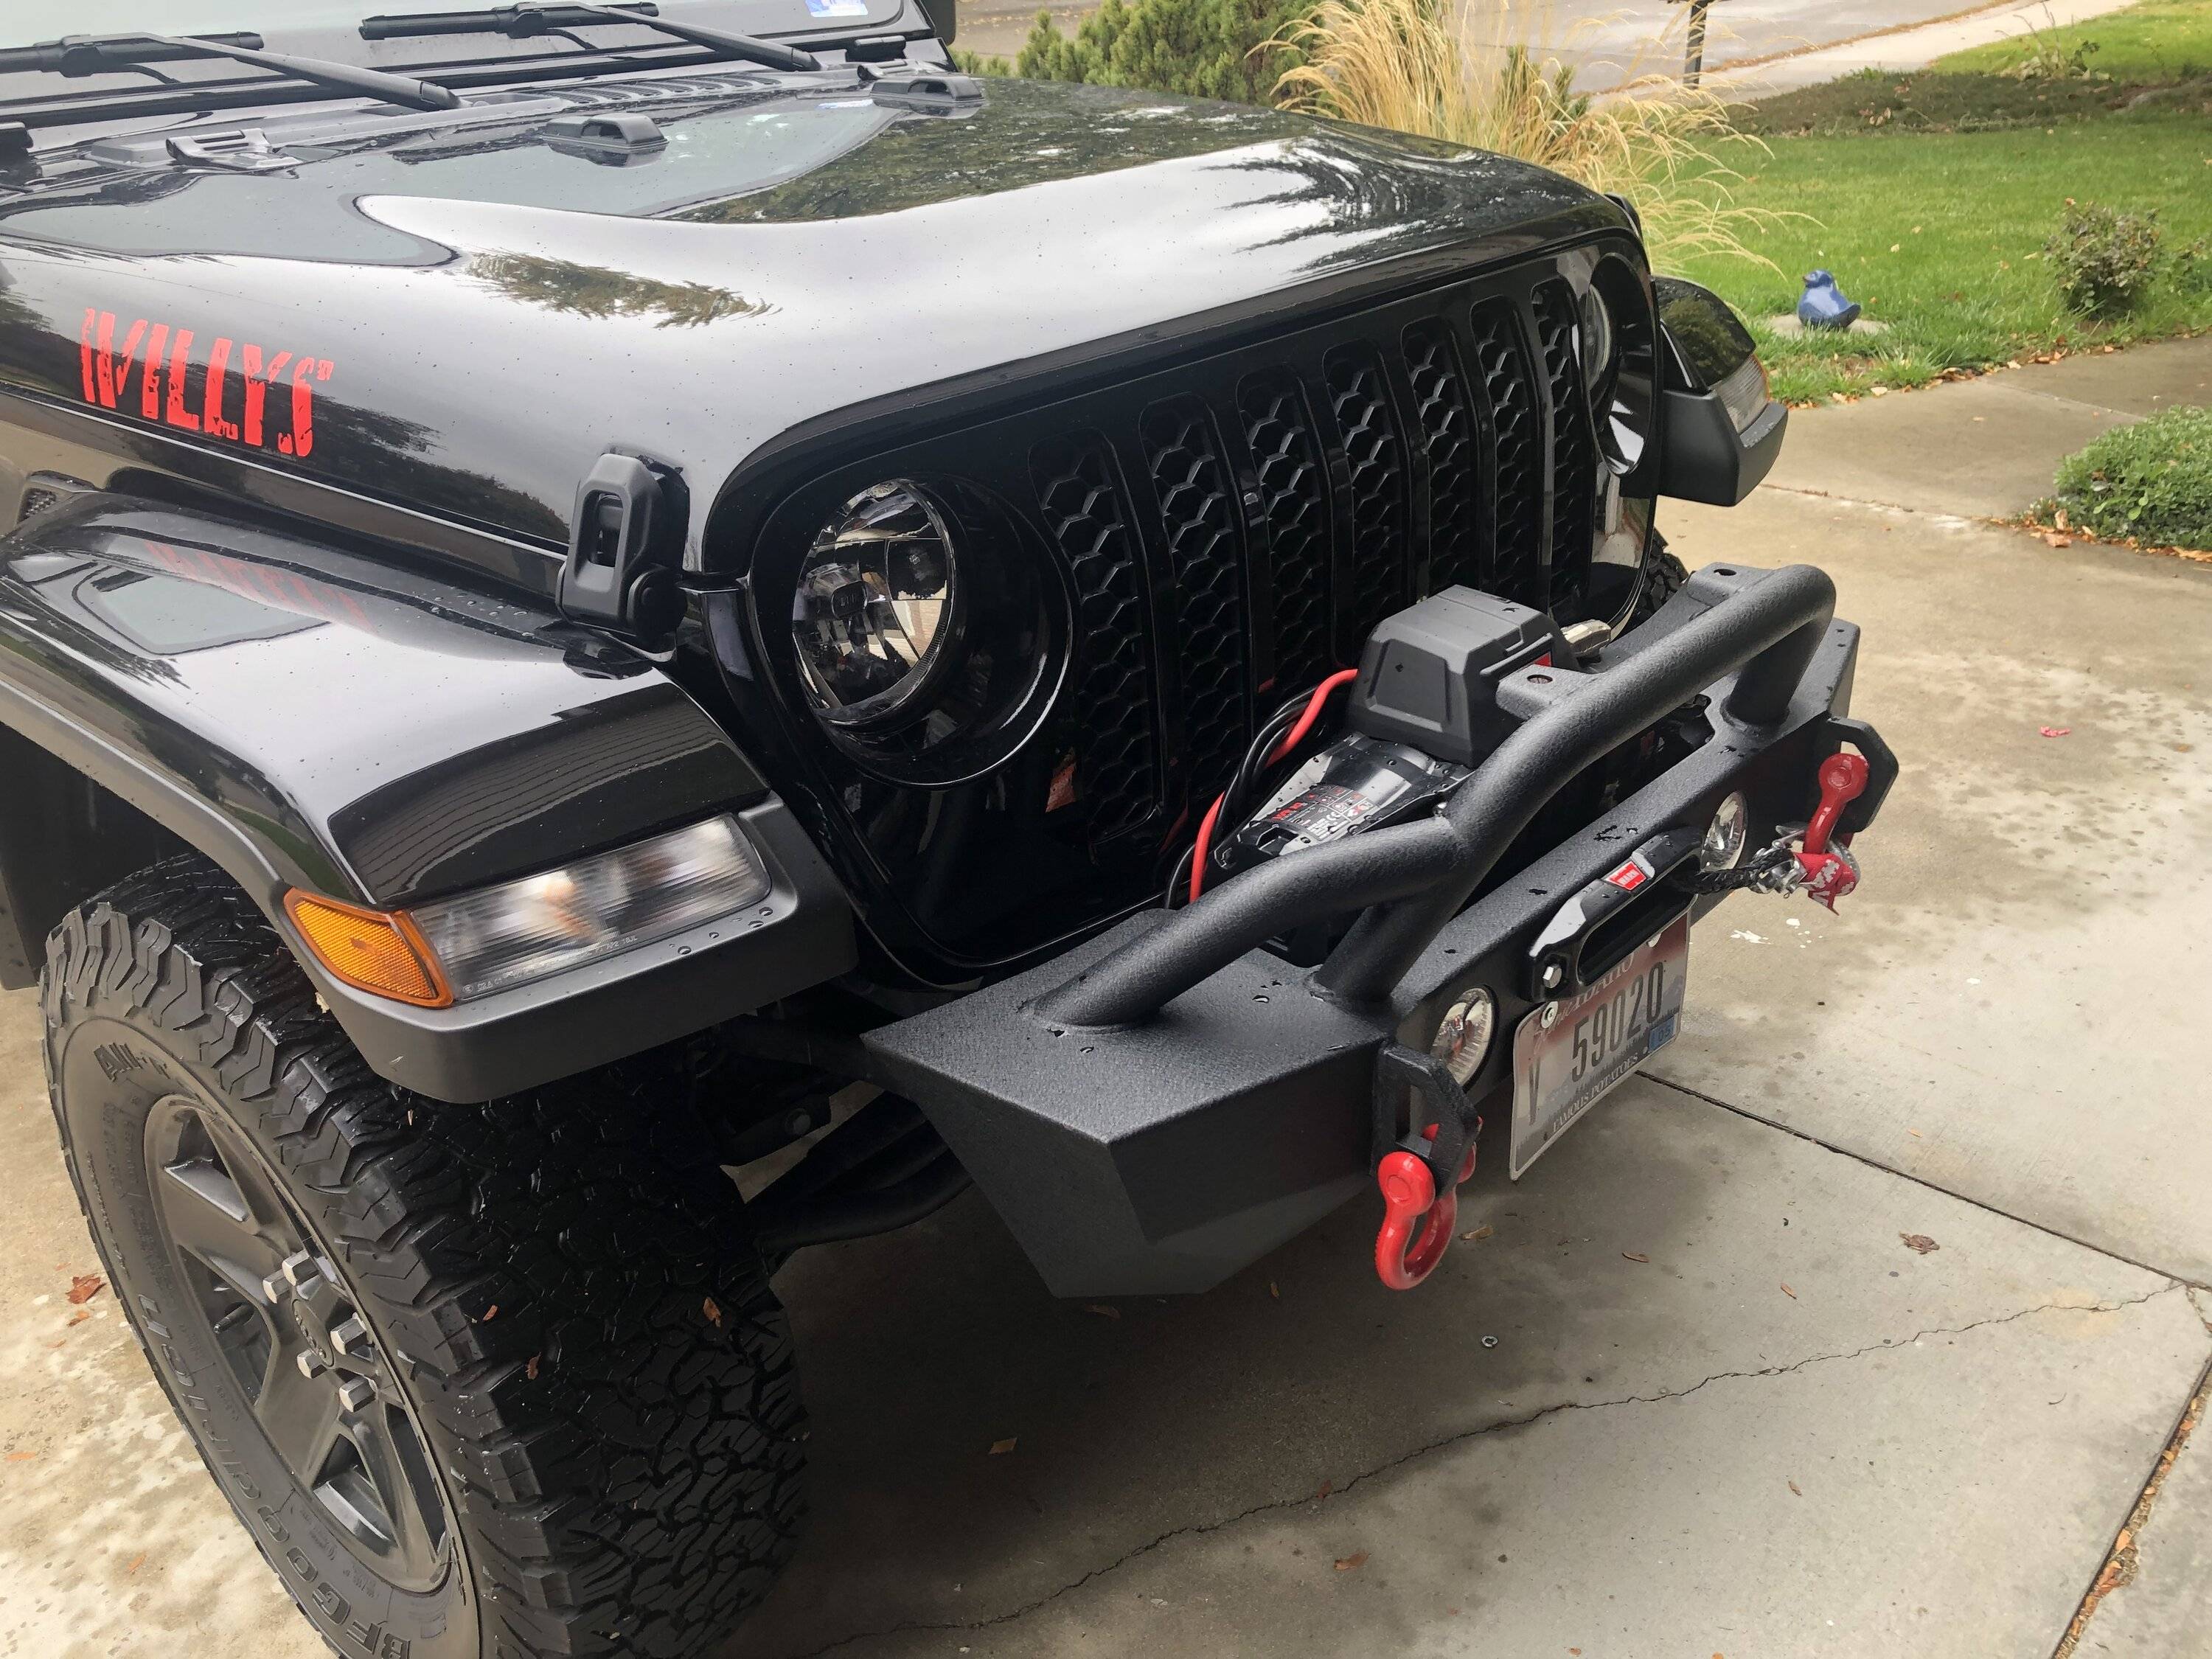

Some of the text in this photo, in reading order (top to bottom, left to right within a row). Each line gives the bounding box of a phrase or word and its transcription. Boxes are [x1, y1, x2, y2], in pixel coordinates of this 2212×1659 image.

[79, 307, 335, 458] WILLYS
[1527, 961, 1664, 1126] V 59020
[1553, 1054, 1639, 1133] FAMOUS POTATOES
